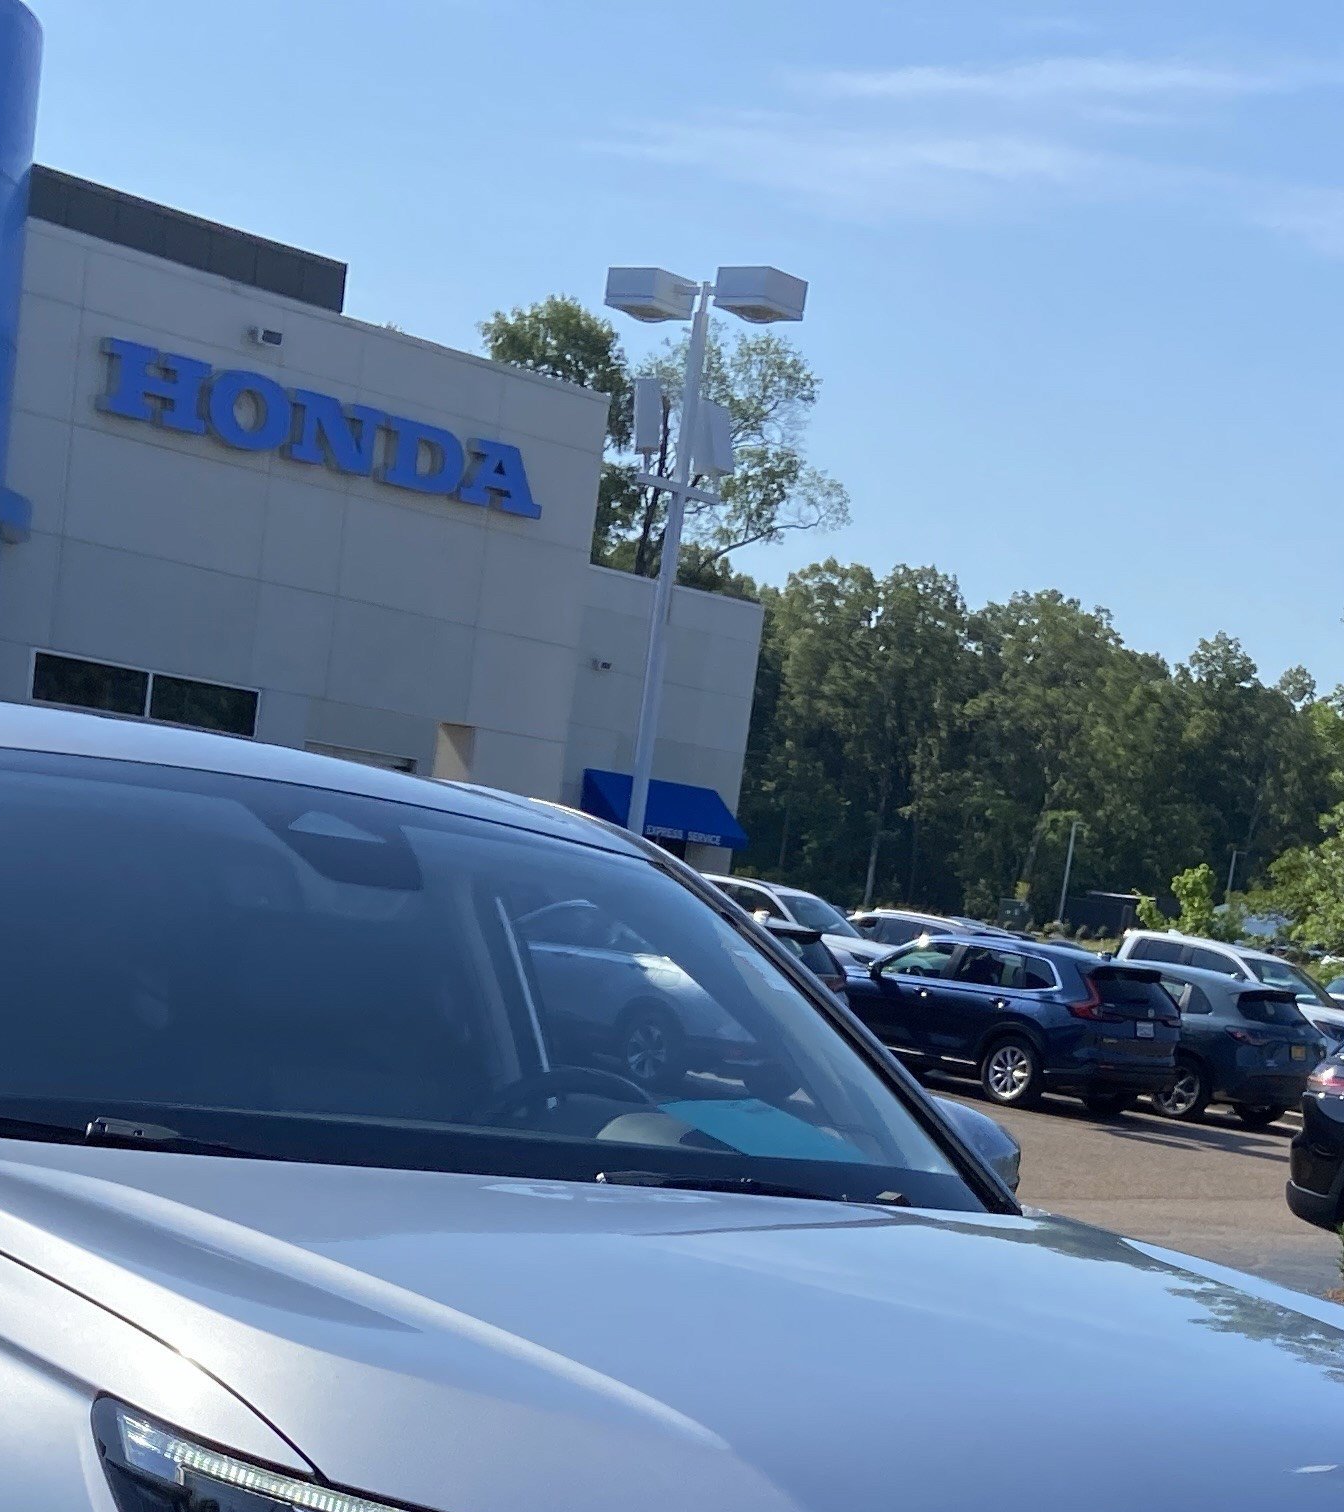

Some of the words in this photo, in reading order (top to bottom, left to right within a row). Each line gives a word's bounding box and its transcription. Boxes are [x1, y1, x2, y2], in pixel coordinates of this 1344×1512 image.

[96, 337, 542, 520] HONDA
[646, 825, 683, 839] EXPRESS
[688, 831, 721, 845] SERVICE
